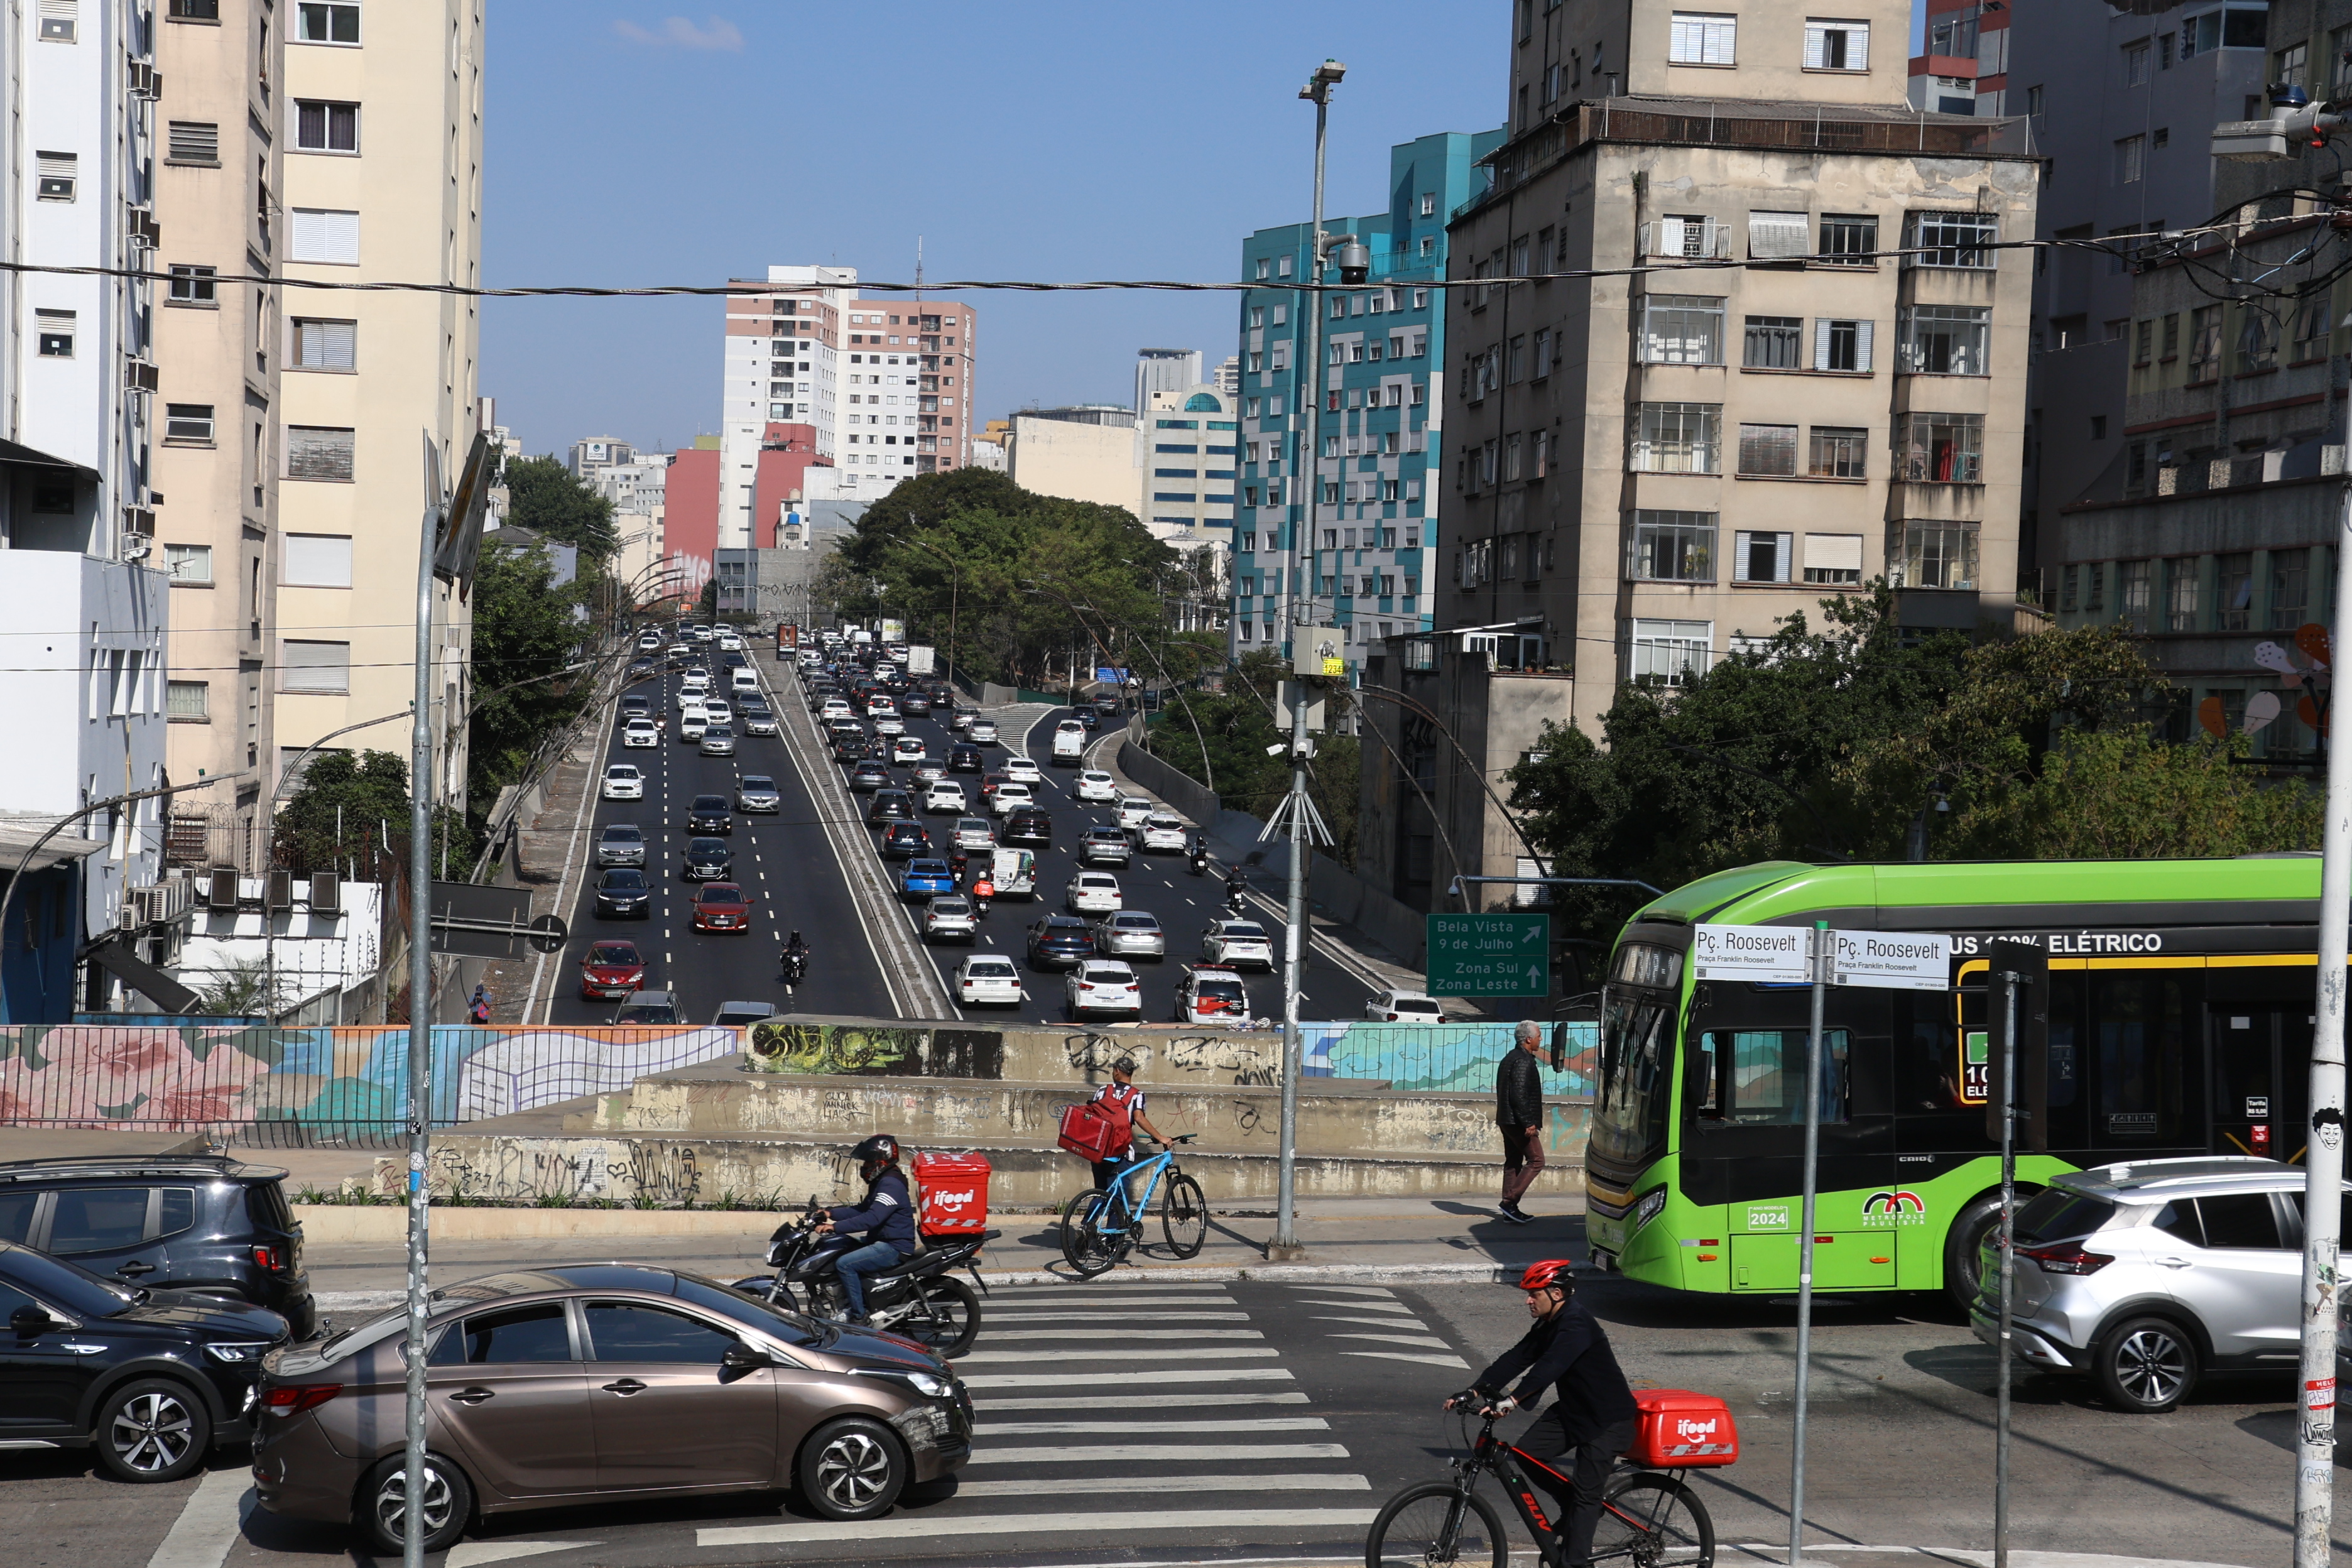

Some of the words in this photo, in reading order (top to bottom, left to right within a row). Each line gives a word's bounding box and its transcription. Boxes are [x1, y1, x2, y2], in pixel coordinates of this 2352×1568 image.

[1325, 665, 1342, 673] 1234
[1437, 921, 1468, 932] Bela
[1475, 921, 1513, 932] Vista
[1439, 939, 1447, 949] 9
[1452, 939, 1468, 949] de
[1474, 939, 1513, 949] Julho
[1697, 932, 1719, 953] Pç.
[1726, 932, 1796, 951] Roosevelt
[1949, 937, 1978, 954] US
[2049, 930, 2162, 953] ELÉTRICO
[1838, 938, 1861, 960] Pç.
[1867, 939, 1940, 959] Roosevelt
[1697, 955, 1716, 963] Praça
[1456, 962, 1490, 974] Zona
[1496, 962, 1518, 974] Sul
[1838, 961, 1856, 969] Praça
[1885, 963, 1917, 971] Roosevelt
[1436, 979, 1471, 990] Zona
[1477, 979, 1518, 990] Leste
[934, 1189, 974, 1206] ifood
[1751, 1212, 1786, 1225] 2024
[1677, 1418, 1716, 1437] ifood
